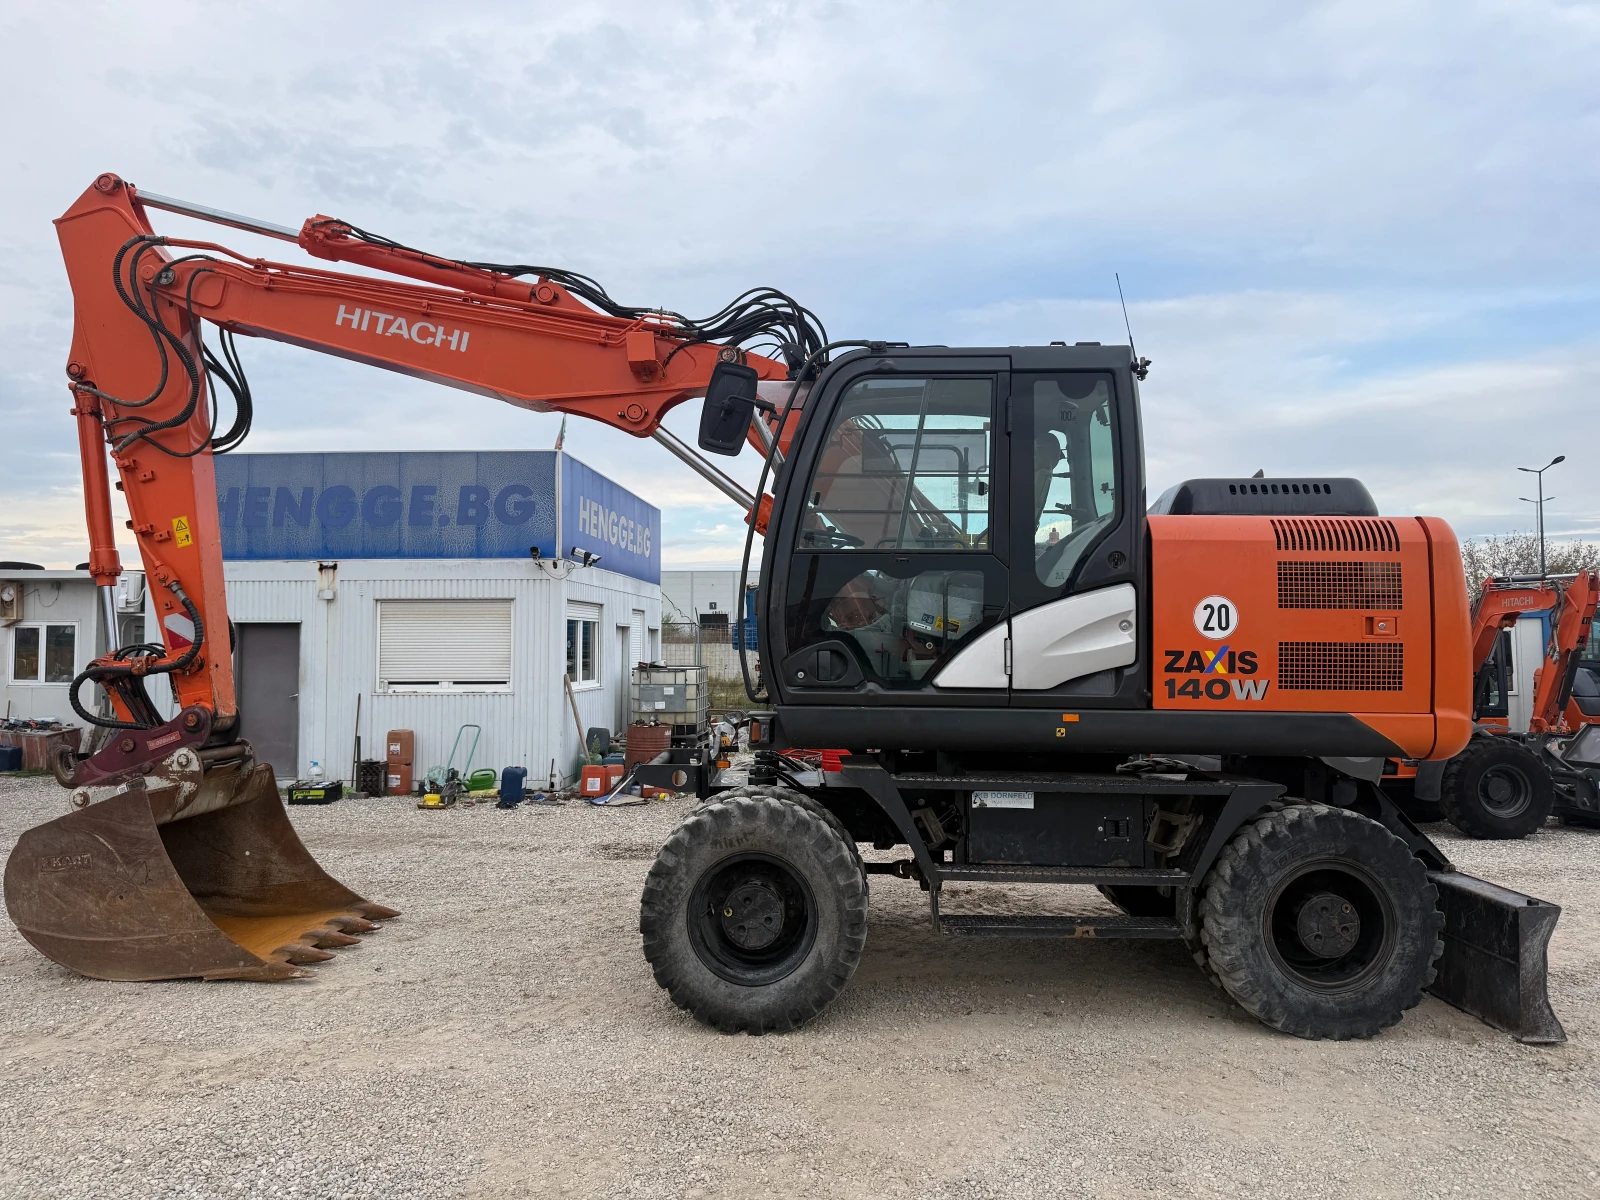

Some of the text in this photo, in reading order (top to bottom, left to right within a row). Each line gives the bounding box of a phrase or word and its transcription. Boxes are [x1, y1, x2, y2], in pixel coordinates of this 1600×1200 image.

[335, 304, 470, 353] HITACHI
[1060, 410, 1072, 422] 100
[579, 495, 651, 558] HENGGE.BG
[1501, 595, 1534, 608] HITACHI
[1202, 603, 1230, 632] 20
[1164, 645, 1258, 674] ZAXIS
[1164, 678, 1270, 701] 140W
